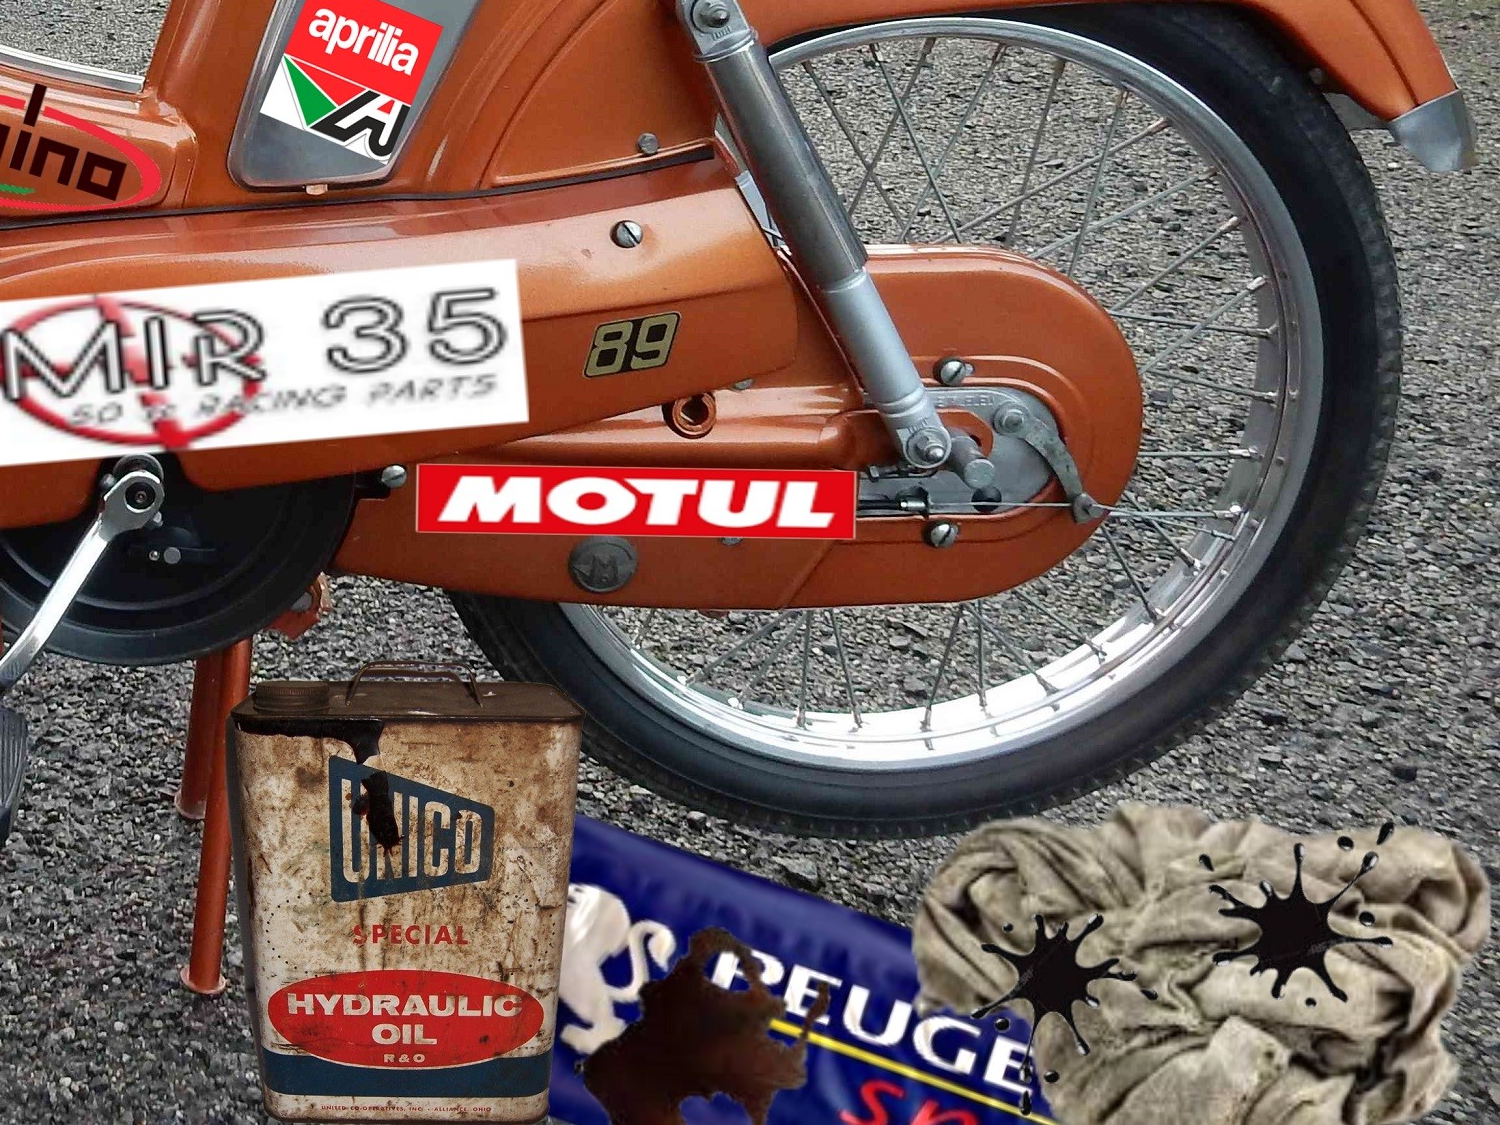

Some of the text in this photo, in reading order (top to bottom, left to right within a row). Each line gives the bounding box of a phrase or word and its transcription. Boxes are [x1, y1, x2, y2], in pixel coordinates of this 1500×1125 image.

[308, 7, 420, 76] aprilia
[2, 287, 507, 402] MIR 35
[586, 313, 679, 376] 89
[365, 374, 499, 405] PARTS
[438, 476, 835, 528] MOTUL
[353, 924, 469, 945] SPECIAL
[287, 993, 523, 1017] HYDRAULIC
[371, 1023, 438, 1045] OIL
